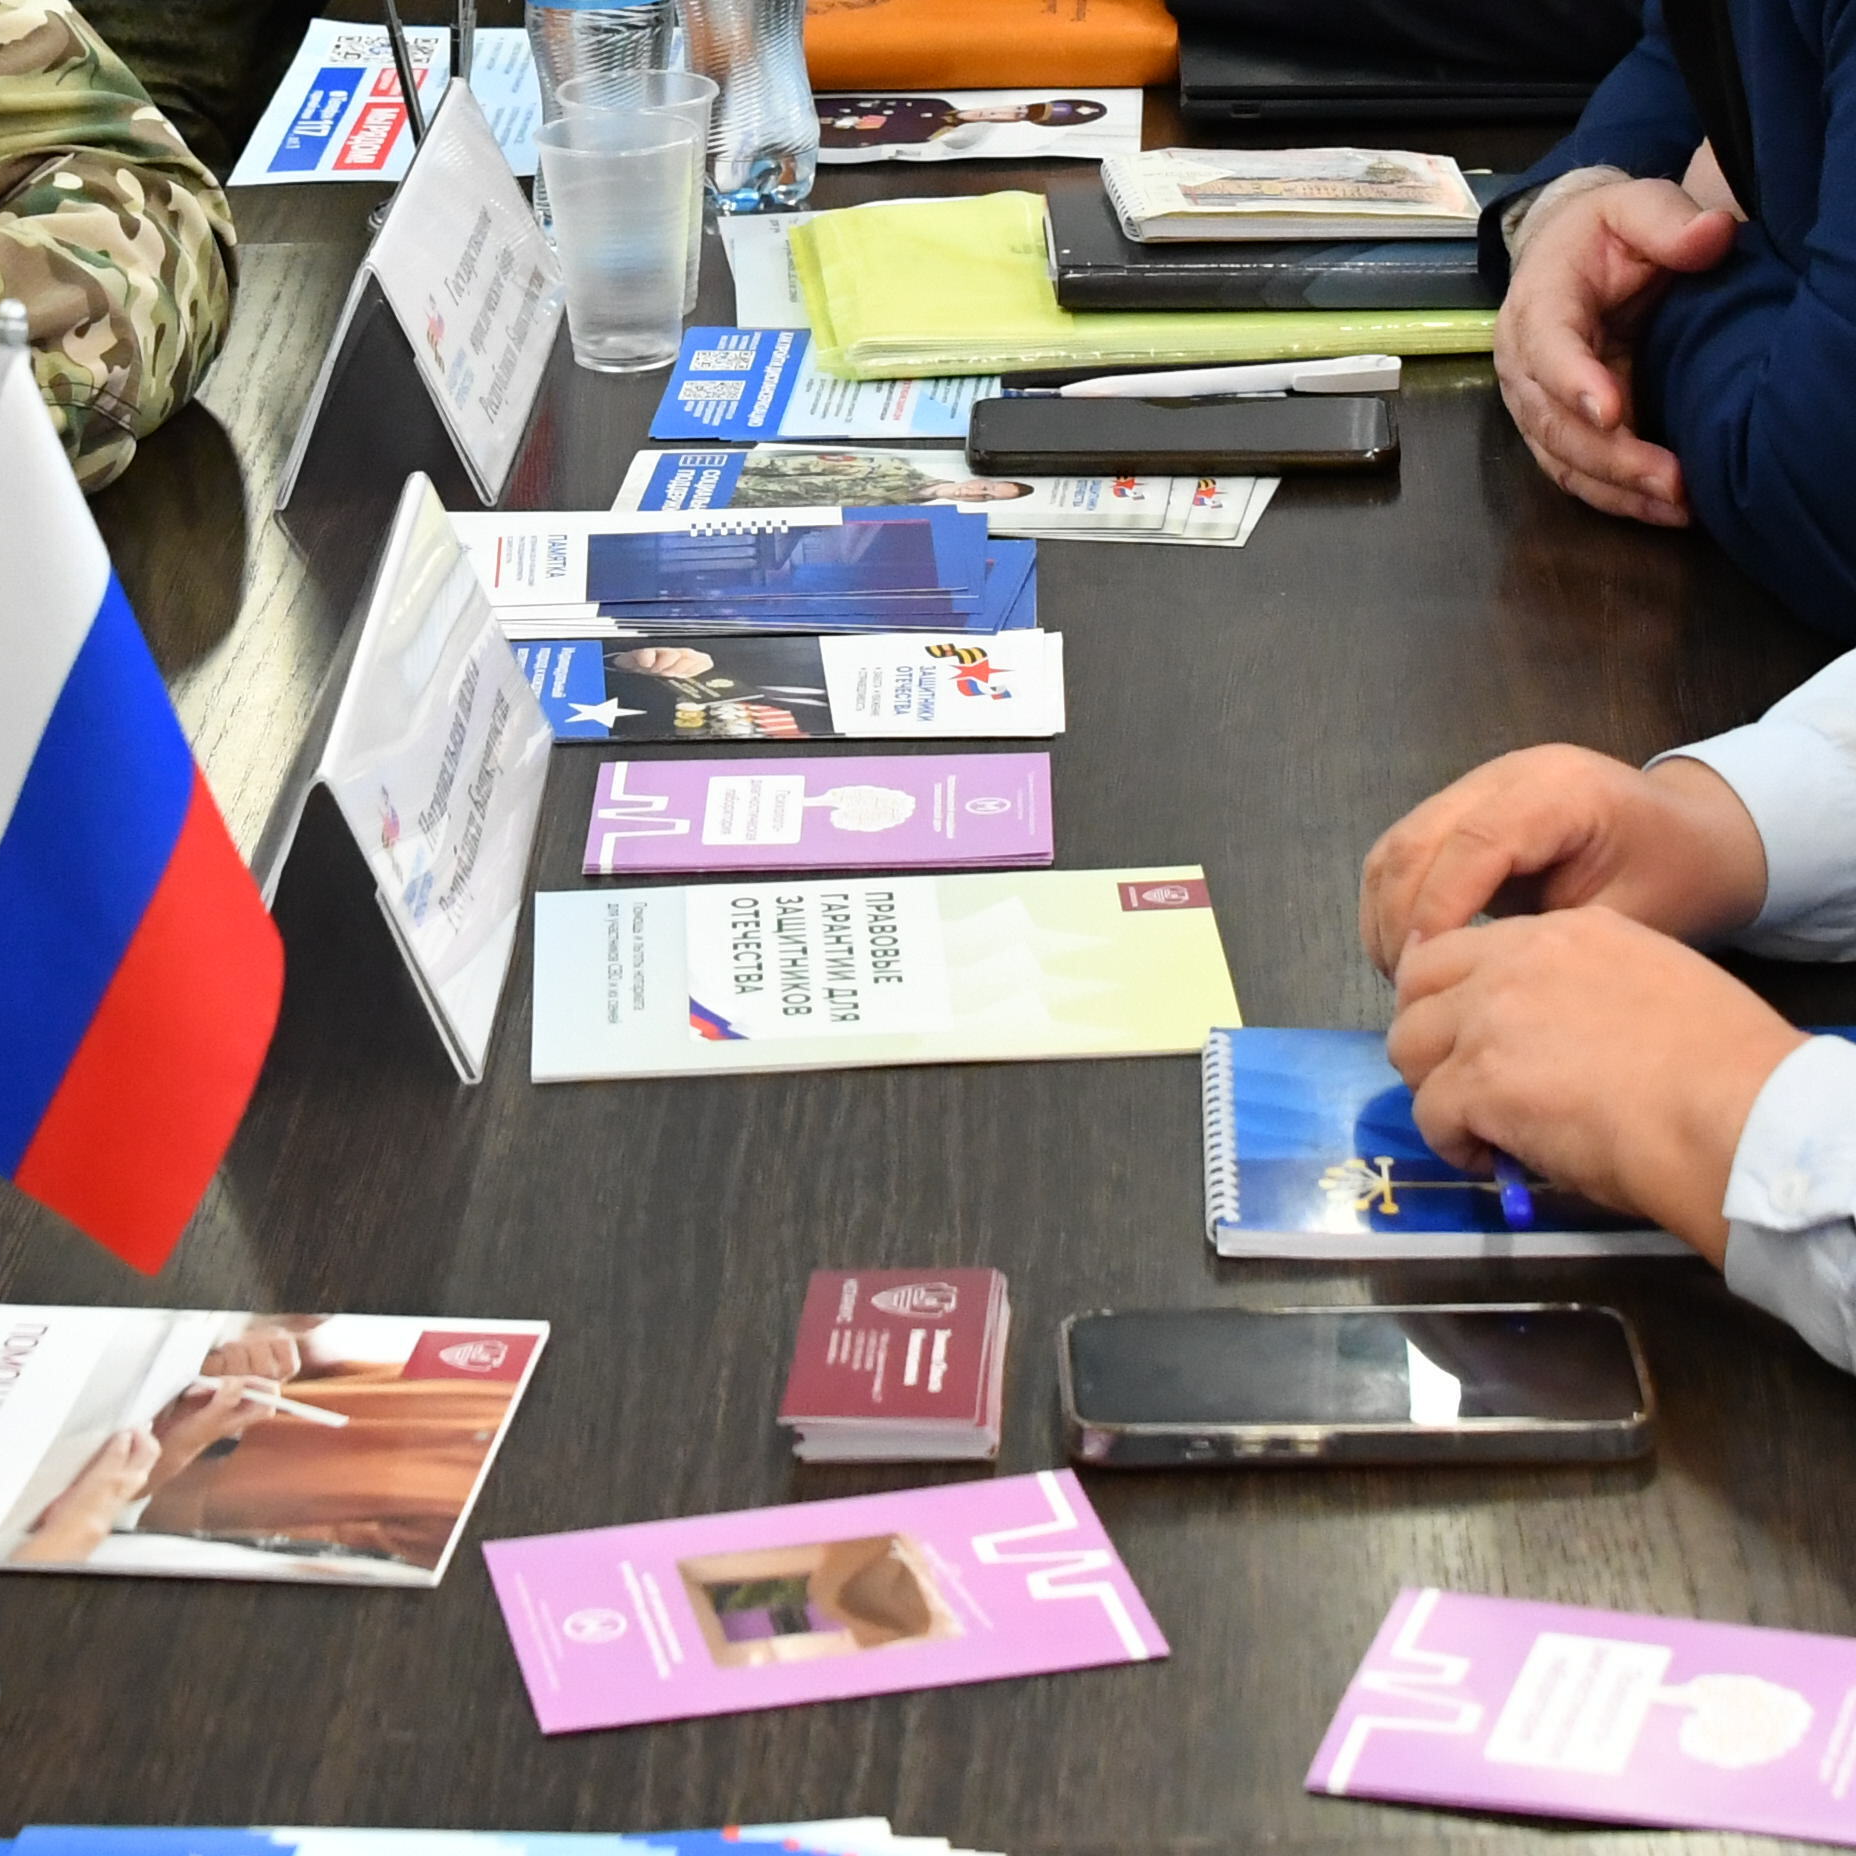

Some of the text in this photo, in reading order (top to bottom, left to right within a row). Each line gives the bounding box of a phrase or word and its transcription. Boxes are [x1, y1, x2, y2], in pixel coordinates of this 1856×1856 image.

[545, 534, 568, 579] ПАМЯТКА
[894, 665, 913, 715] ОТЕЧЕСТВА
[916, 665, 937, 722] ЗАЩИТНИКИ
[730, 896, 765, 995] ОТЕЧЕСТВА
[772, 895, 813, 1016] ЗАЩИТНИКОВ
[820, 893, 861, 1022] ГАРАНТИИ ДЛЯ
[865, 891, 904, 984] ПРАВОВЫЕ
